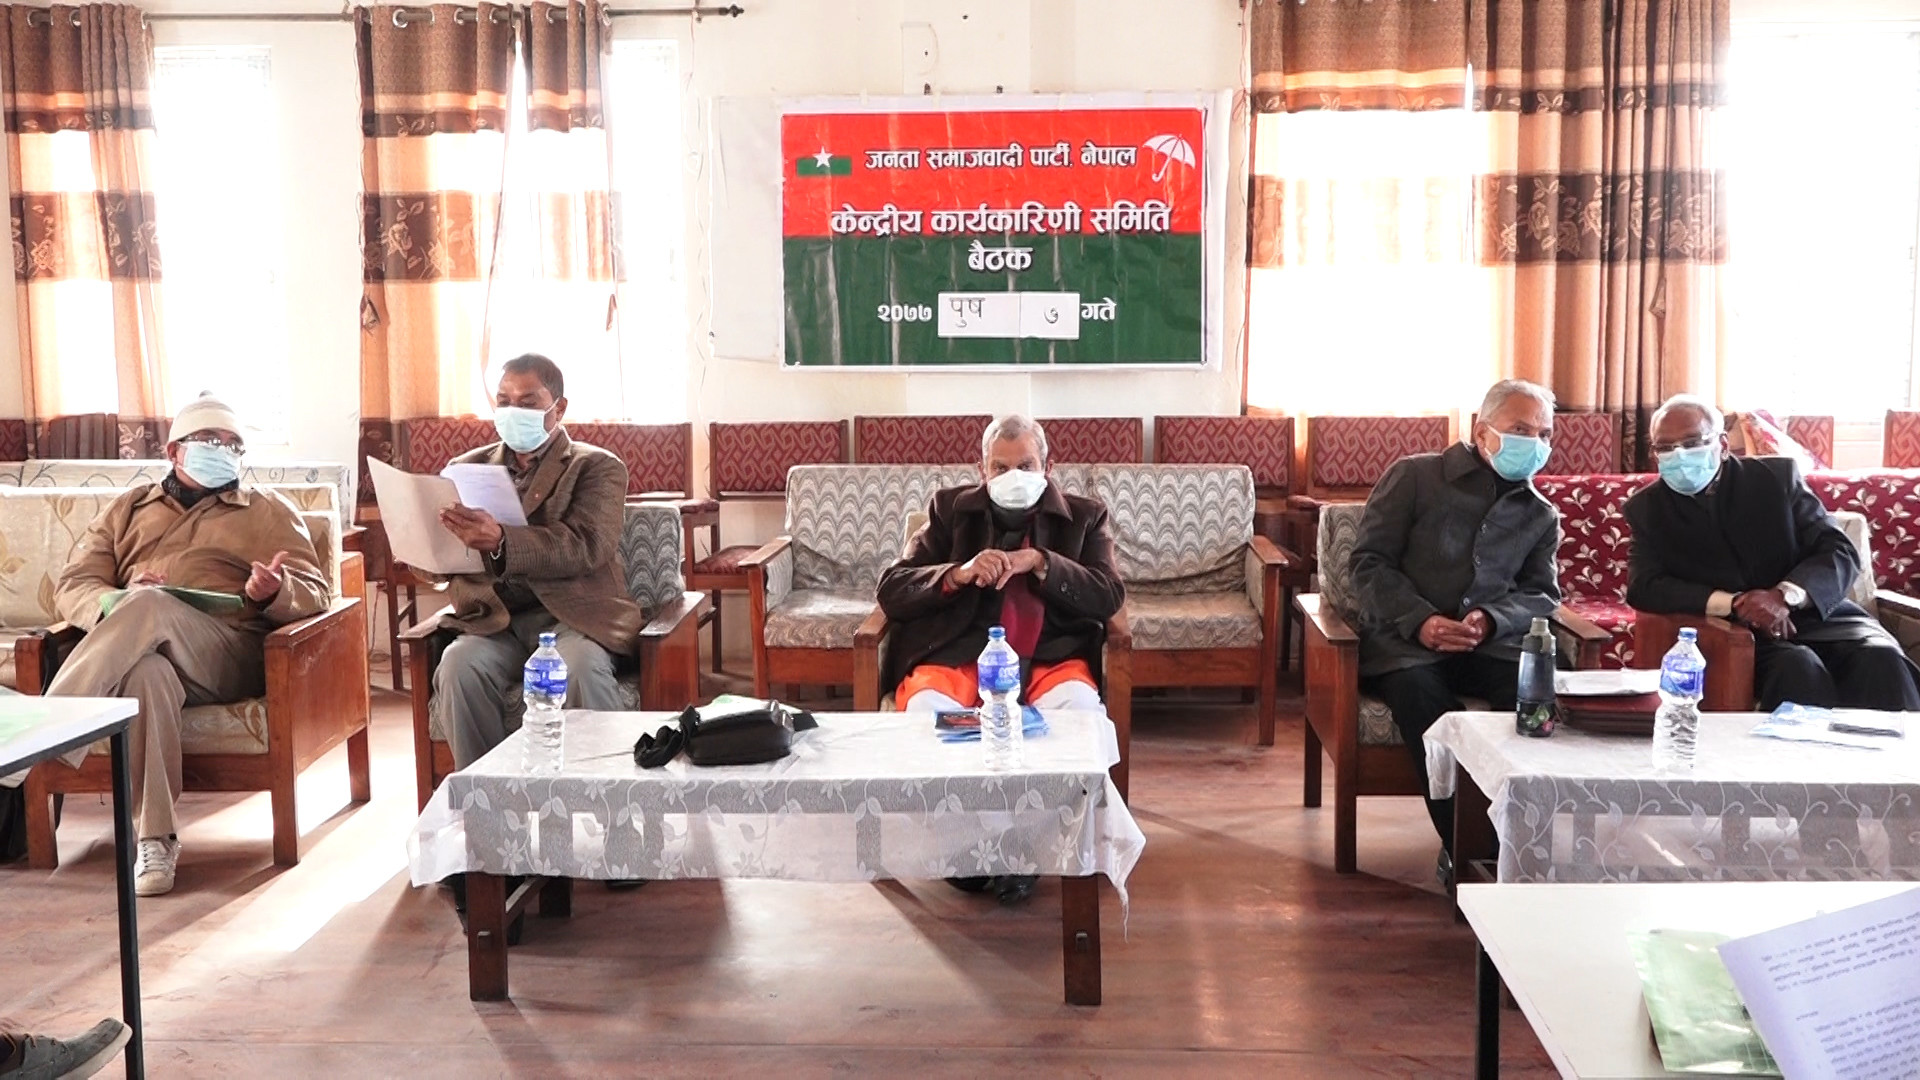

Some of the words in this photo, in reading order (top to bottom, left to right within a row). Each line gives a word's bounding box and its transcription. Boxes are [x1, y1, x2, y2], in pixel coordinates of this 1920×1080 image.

[865, 150, 921, 169] जनता
[926, 143, 1024, 169] समाजवादी
[1081, 141, 1138, 167] नेपाल
[831, 203, 923, 236] केन्द्रीय
[931, 202, 1083, 233] कार्यकारिणी
[1090, 200, 1173, 233] समिति
[968, 239, 1034, 271] बैठक
[877, 303, 932, 322] २०७७
[1081, 297, 1117, 321] गते
